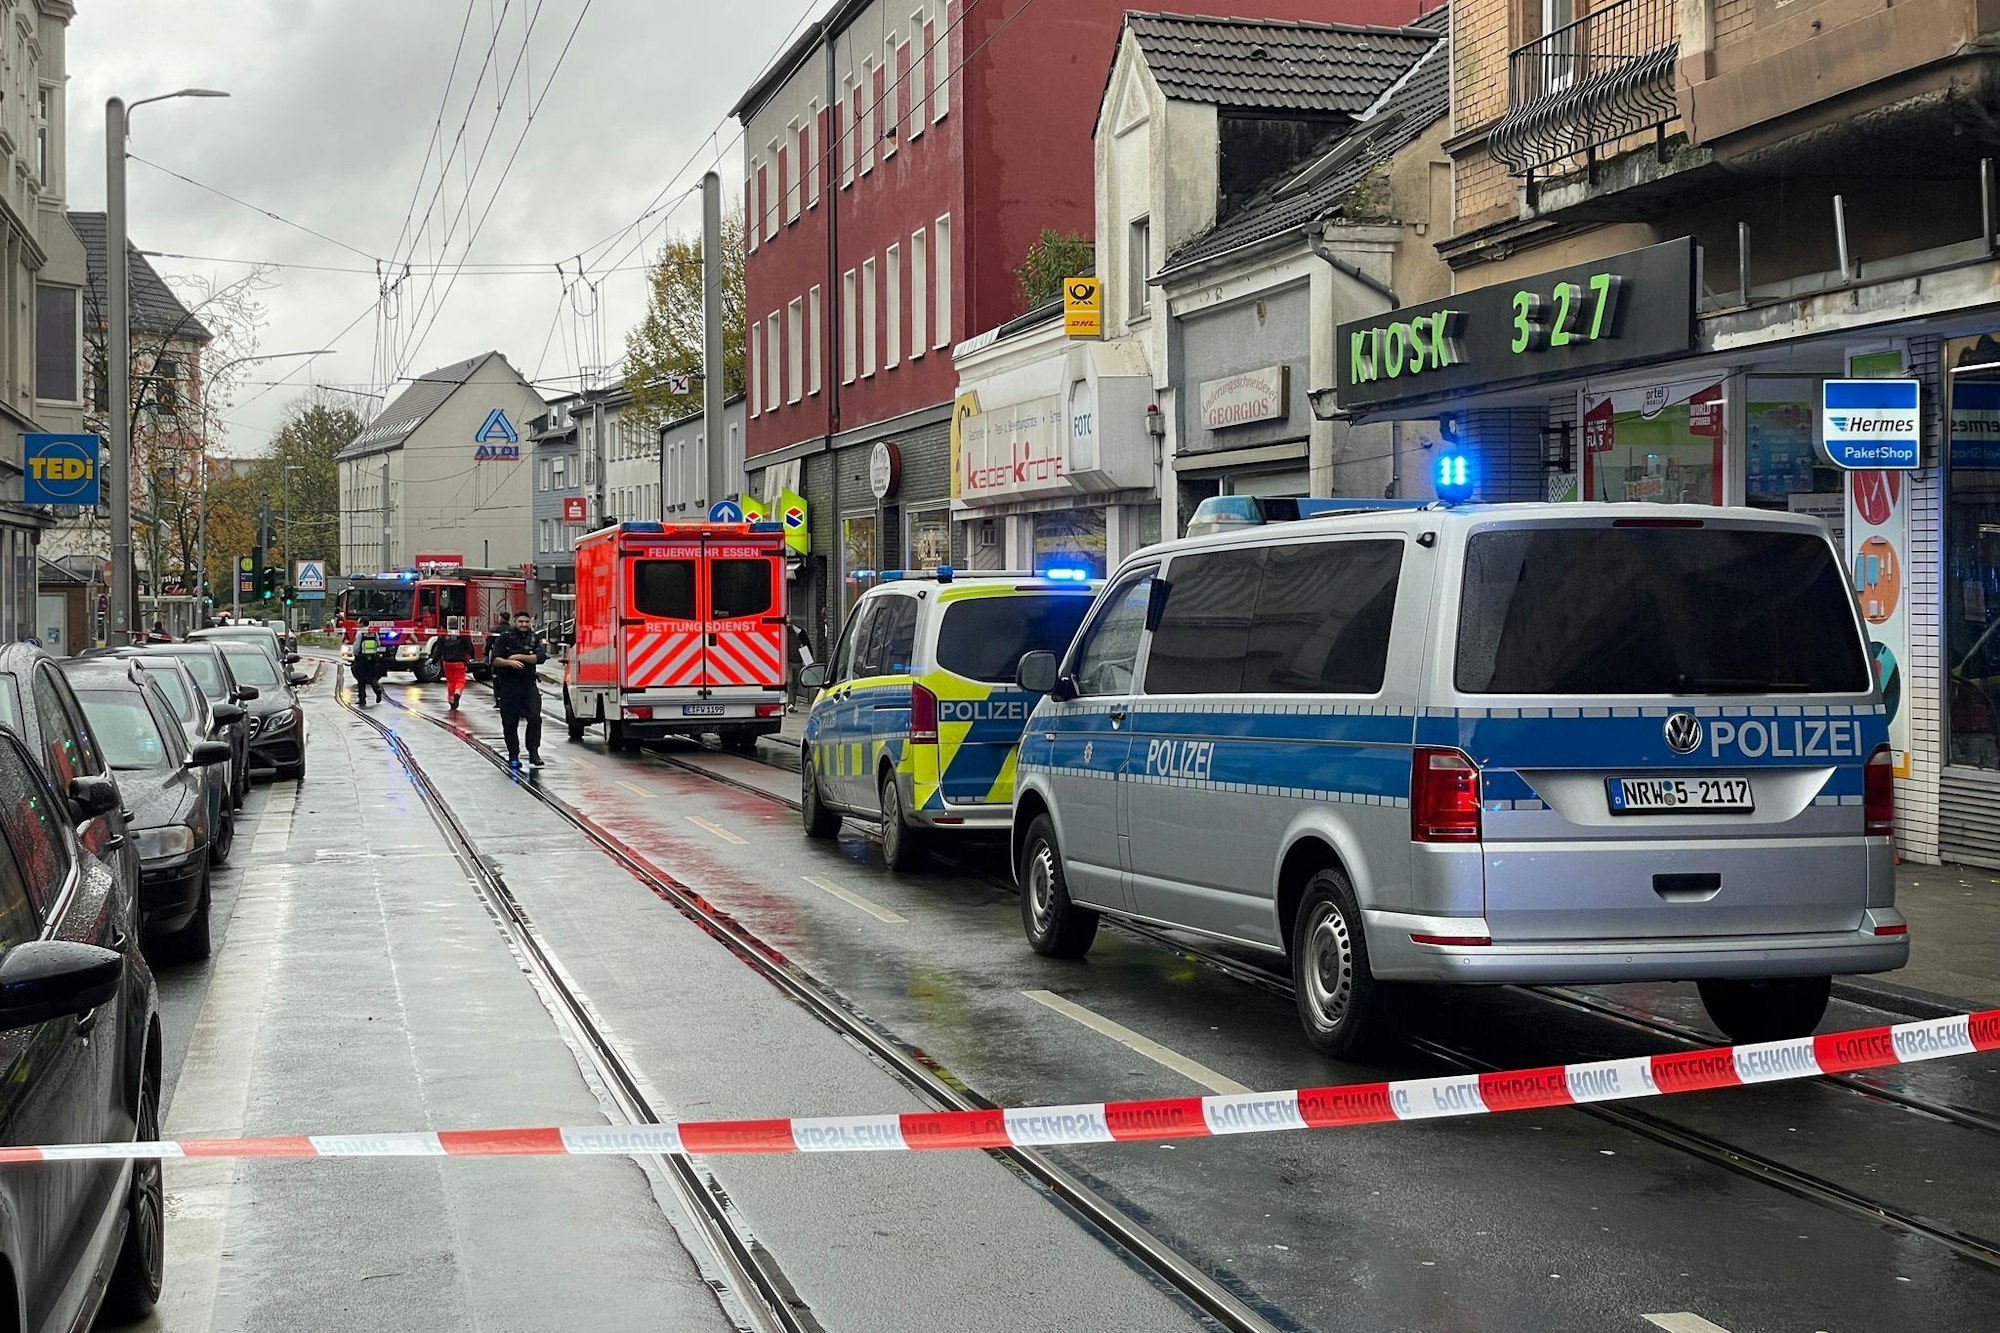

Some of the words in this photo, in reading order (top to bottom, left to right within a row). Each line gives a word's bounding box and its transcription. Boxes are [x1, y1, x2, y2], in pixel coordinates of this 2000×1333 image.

[1350, 309, 1450, 385] KIOSK
[1511, 272, 1611, 354] 327
[1646, 386, 1664, 399] ortel
[1209, 398, 1269, 425] GEORGIOS
[1849, 417, 1915, 432] Hermes
[475, 445, 519, 457] ALDI
[1845, 446, 1914, 460] PaketShop
[28, 457, 94, 480] TEDi
[648, 547, 720, 558] FEUERWEHR
[723, 547, 759, 557] ESSEN
[645, 621, 758, 633] RETTUNGSDIENST
[940, 702, 1029, 720] POLIZEI
[1710, 721, 1863, 758] POLIZEI
[1145, 738, 1216, 780] POLIZEI
[1622, 781, 1664, 805] NRW
[1674, 780, 1748, 804] 5-2117
